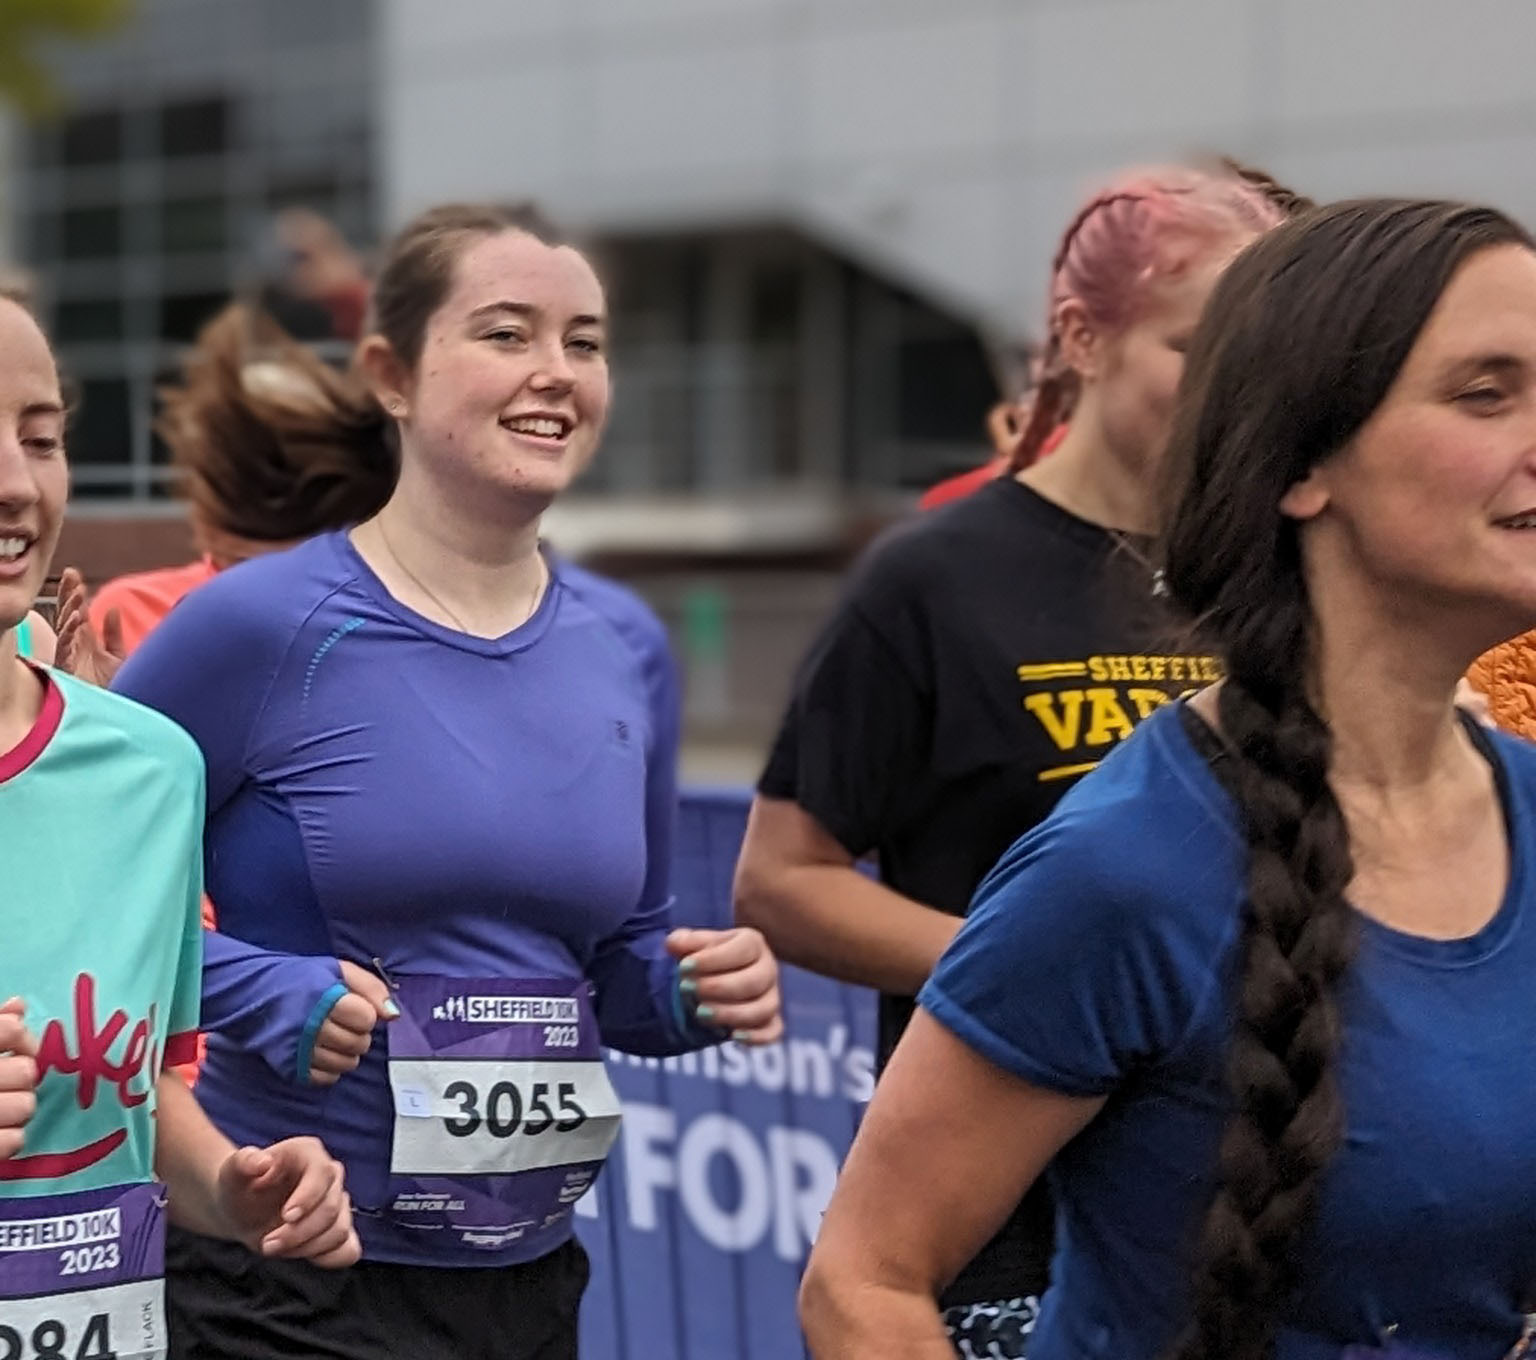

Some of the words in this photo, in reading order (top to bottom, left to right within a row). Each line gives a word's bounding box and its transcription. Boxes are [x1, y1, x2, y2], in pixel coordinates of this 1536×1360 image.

[1087, 655, 1223, 682] SHEFFIE
[471, 999, 552, 1019] SHEFFIELD
[443, 1081, 586, 1138] 3055
[621, 1100, 840, 1262] FOR
[81, 1212, 118, 1239] 10K
[58, 1243, 121, 1276] 2023
